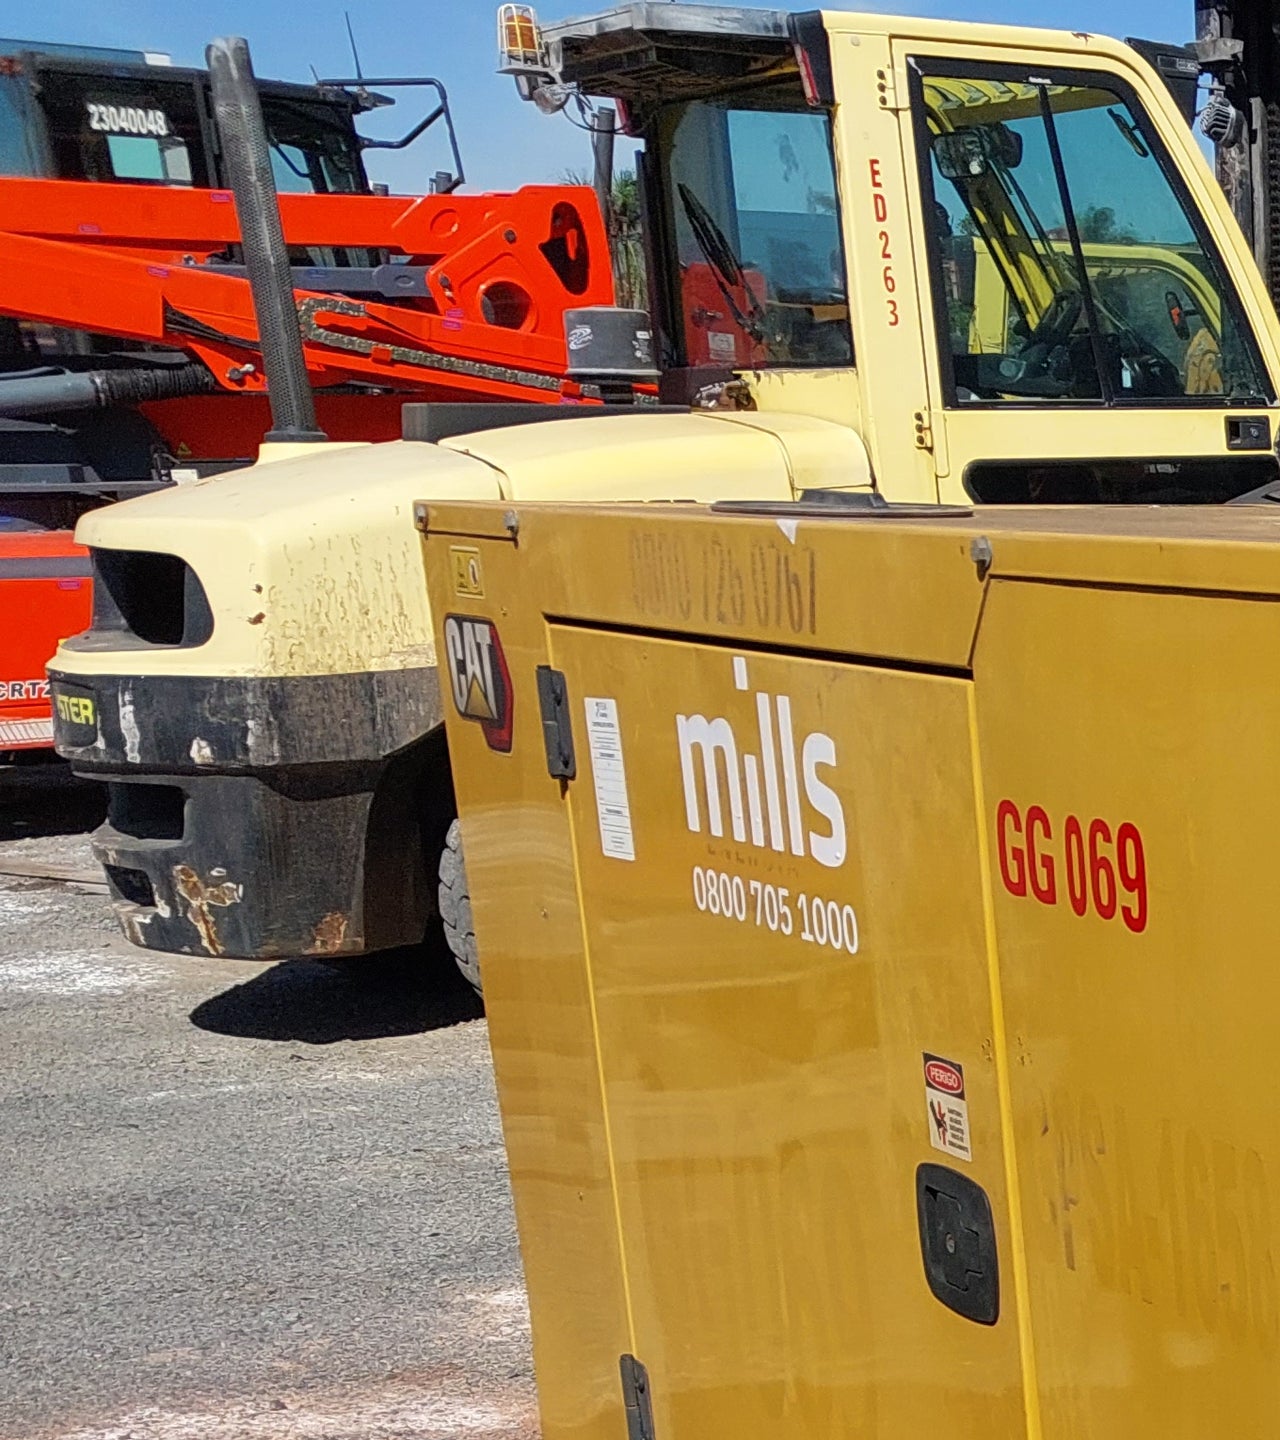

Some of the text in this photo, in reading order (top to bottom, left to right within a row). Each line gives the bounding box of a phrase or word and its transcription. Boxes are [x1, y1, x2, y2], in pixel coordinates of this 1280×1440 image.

[88, 104, 168, 135] 23040048
[445, 617, 498, 720] CAT
[676, 656, 847, 868] mills
[693, 866, 859, 955] 0800 705 1000
[997, 799, 1147, 933] GG 069
